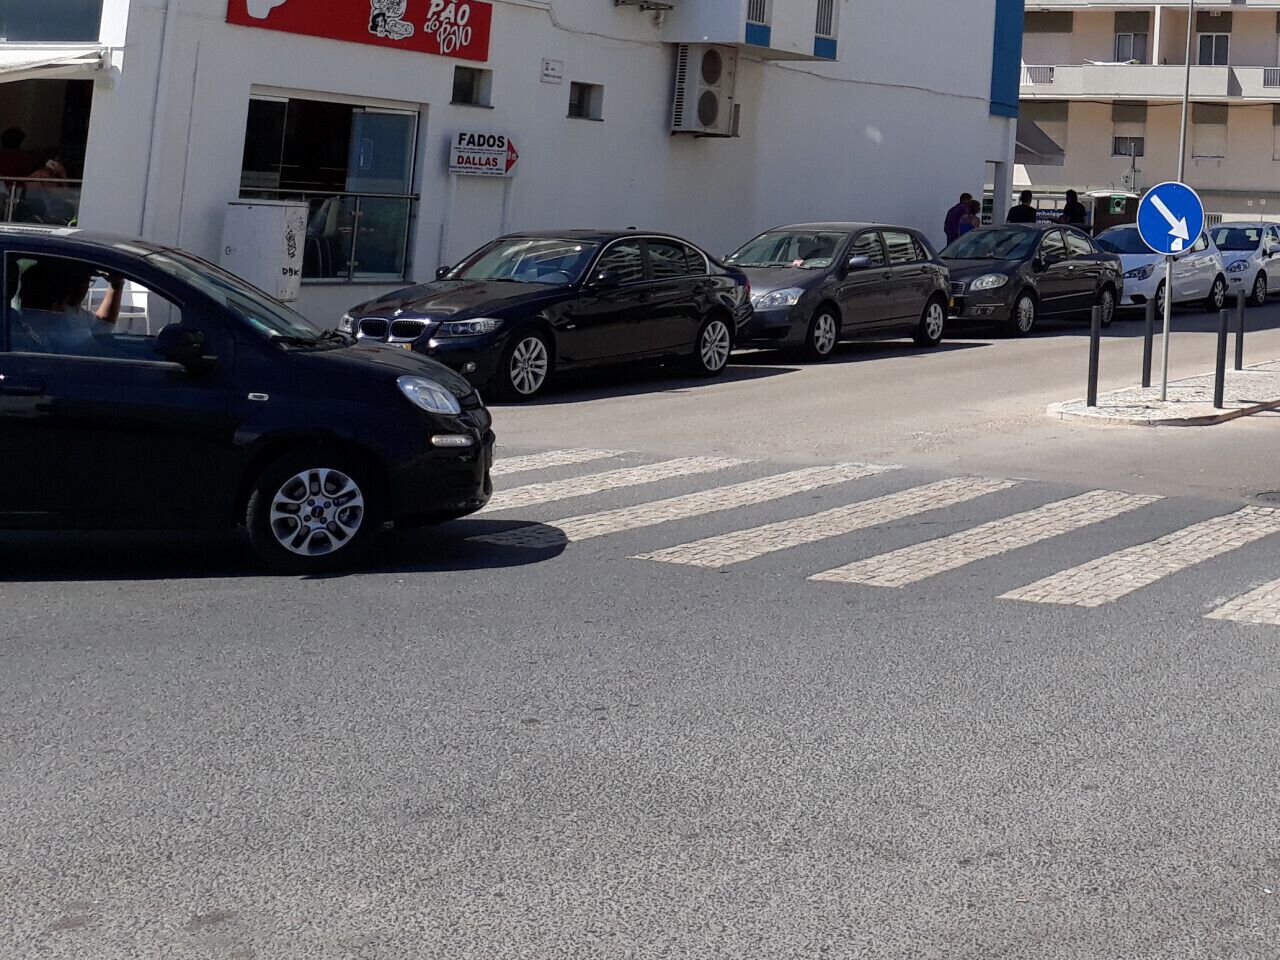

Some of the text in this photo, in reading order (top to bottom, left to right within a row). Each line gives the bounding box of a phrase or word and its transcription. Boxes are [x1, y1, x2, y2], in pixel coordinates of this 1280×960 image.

[424, 14, 439, 33] do
[458, 132, 505, 149] FADOS
[457, 154, 499, 167] DALLAS
